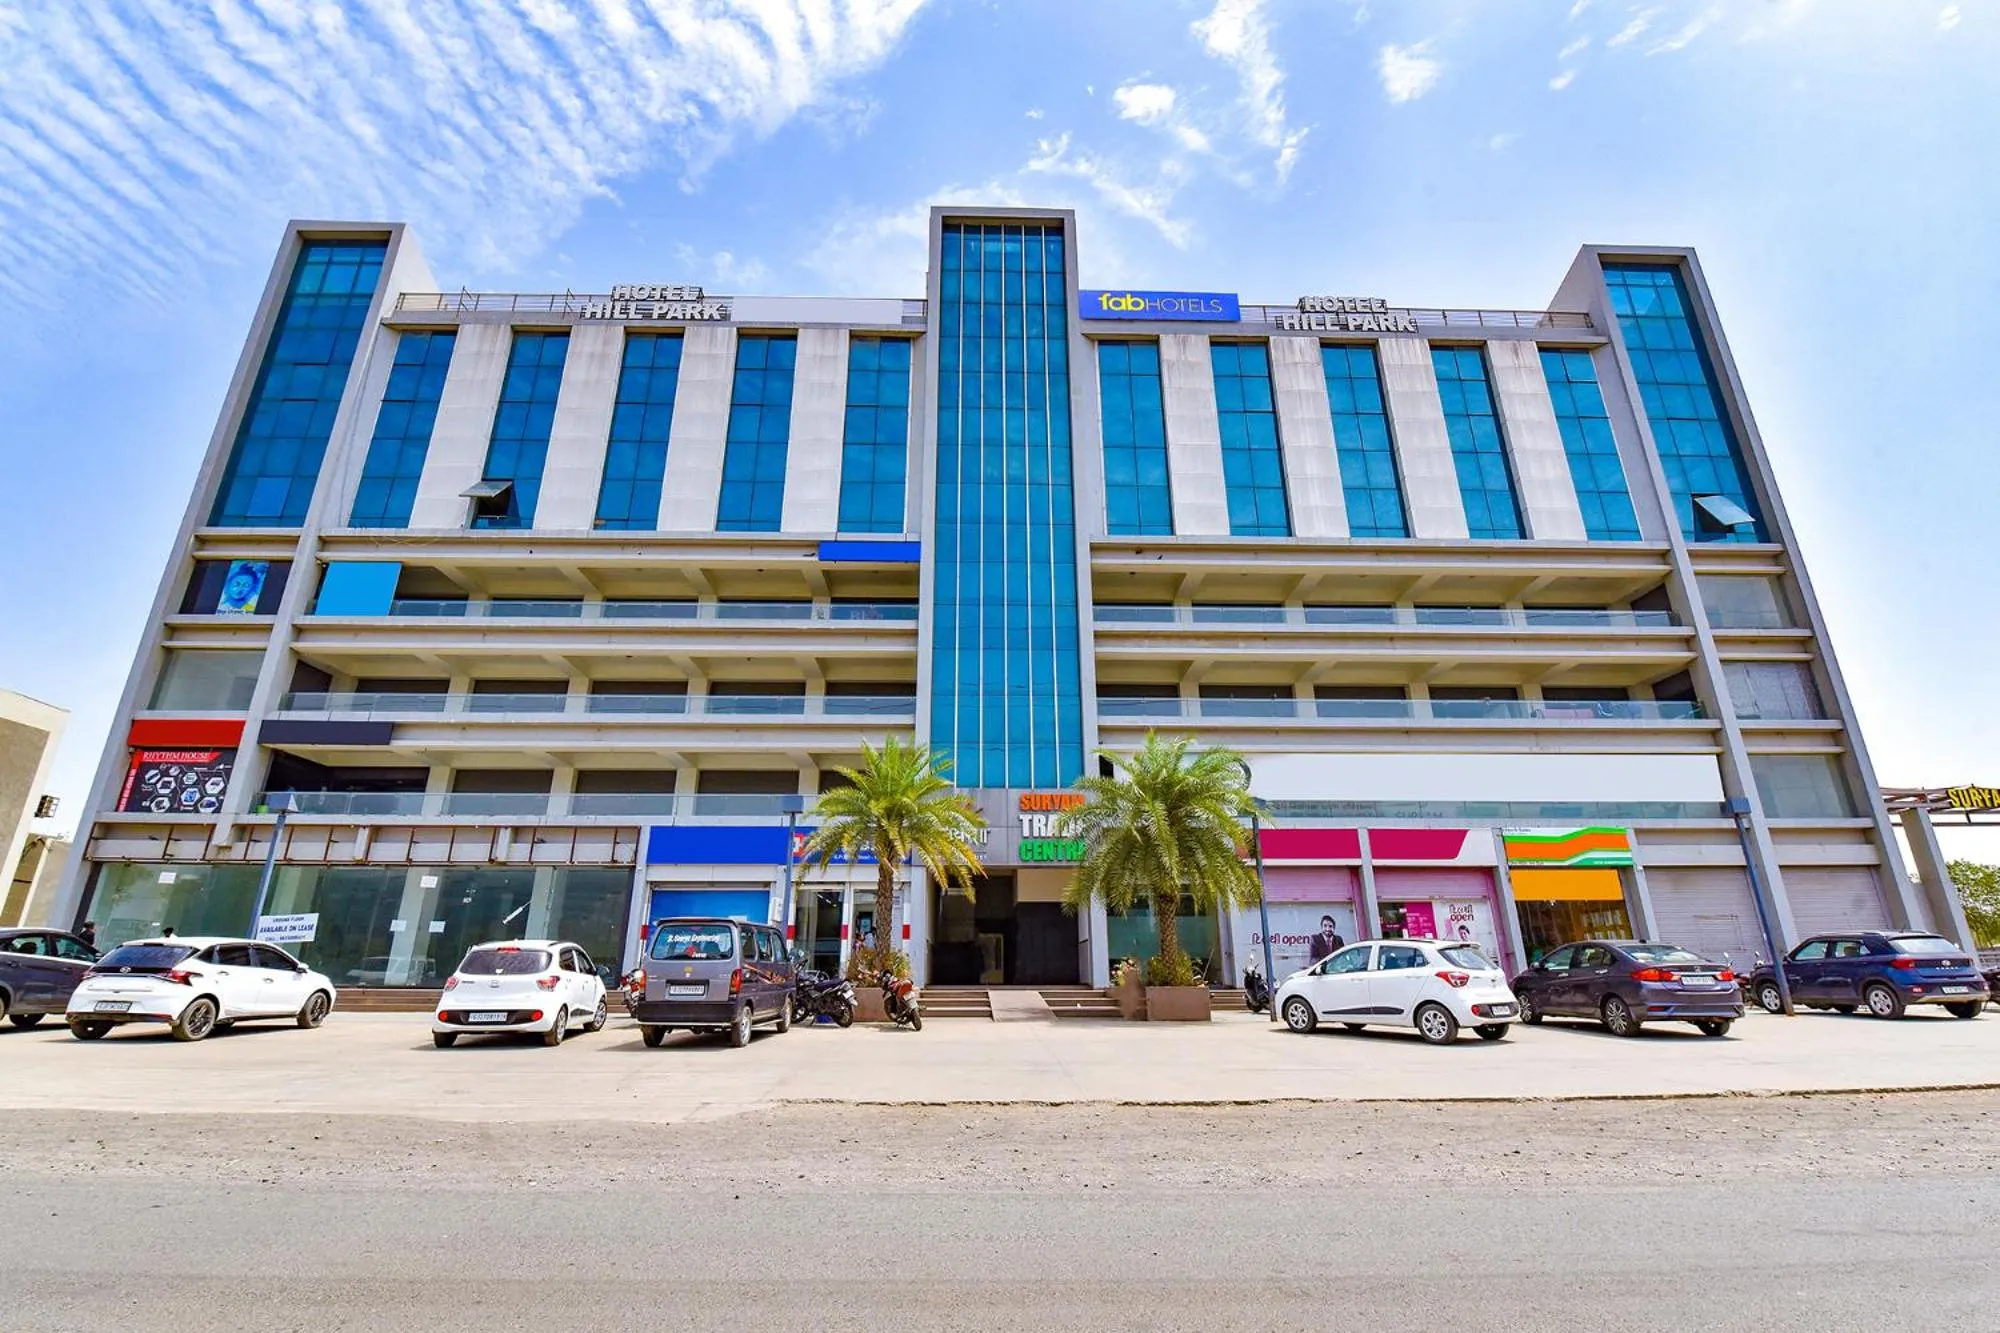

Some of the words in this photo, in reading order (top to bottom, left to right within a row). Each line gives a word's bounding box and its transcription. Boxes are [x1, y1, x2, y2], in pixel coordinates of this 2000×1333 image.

[612, 284, 698, 300] HOTEL
[582, 301, 644, 320] HILL
[652, 302, 723, 321] PARK
[1302, 295, 1388, 313] HOTEL
[1280, 312, 1341, 331] HILL
[1348, 313, 1420, 332] PARK
[143, 751, 181, 760] RHYTHM
[182, 751, 209, 760] HOUSE
[1450, 914, 1474, 922] open
[1282, 935, 1310, 946] open
